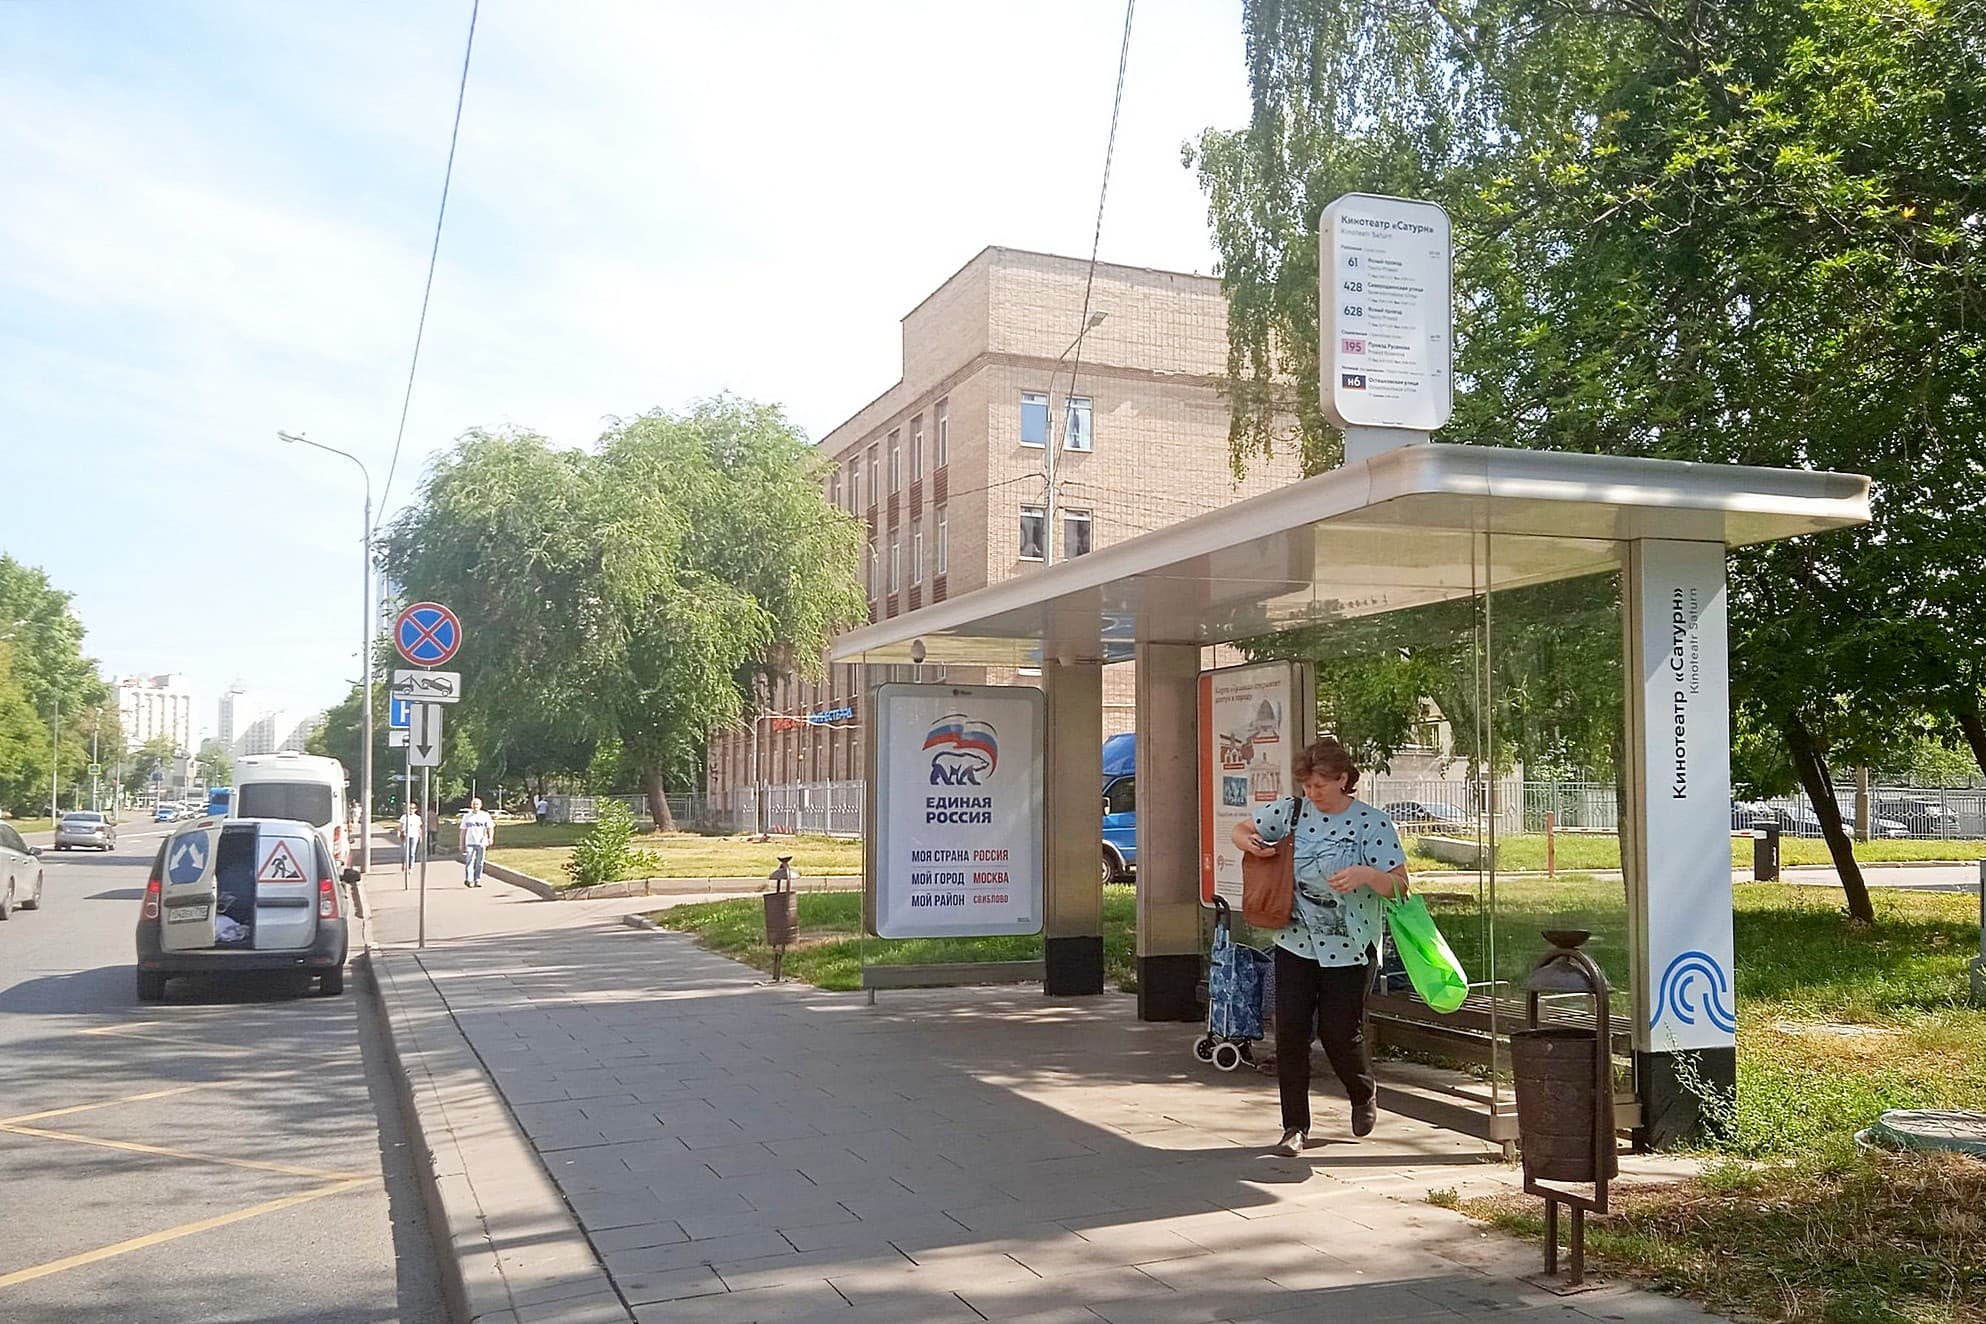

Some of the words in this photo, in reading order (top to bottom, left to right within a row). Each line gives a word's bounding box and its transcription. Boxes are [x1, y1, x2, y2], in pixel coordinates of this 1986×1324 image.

[1341, 216, 1390, 230] Кинотеатр
[1392, 220, 1434, 234] «Сатурн»
[1348, 257, 1358, 267] 61
[1344, 281, 1363, 292] 428
[1344, 306, 1363, 316] 628
[1345, 341, 1362, 352] 195
[1688, 588, 1698, 629] Saturn
[1670, 588, 1687, 682] «Сатурн»
[1689, 632, 1699, 694] Kinoteatr
[1672, 691, 1687, 799] Кинотеатр
[926, 796, 992, 810] ЕДИНАЯ
[926, 811, 992, 824] РОССИЯ
[912, 850, 932, 863] МОЯ
[934, 849, 969, 863] СТРАНА
[973, 849, 1009, 862] РОССИЯ
[912, 870, 932, 885] МОЙ
[934, 871, 965, 886] ГОРОД
[973, 871, 1009, 884] МОСКВА
[911, 892, 932, 907] МОЙ
[934, 892, 965, 907] РАЙОН
